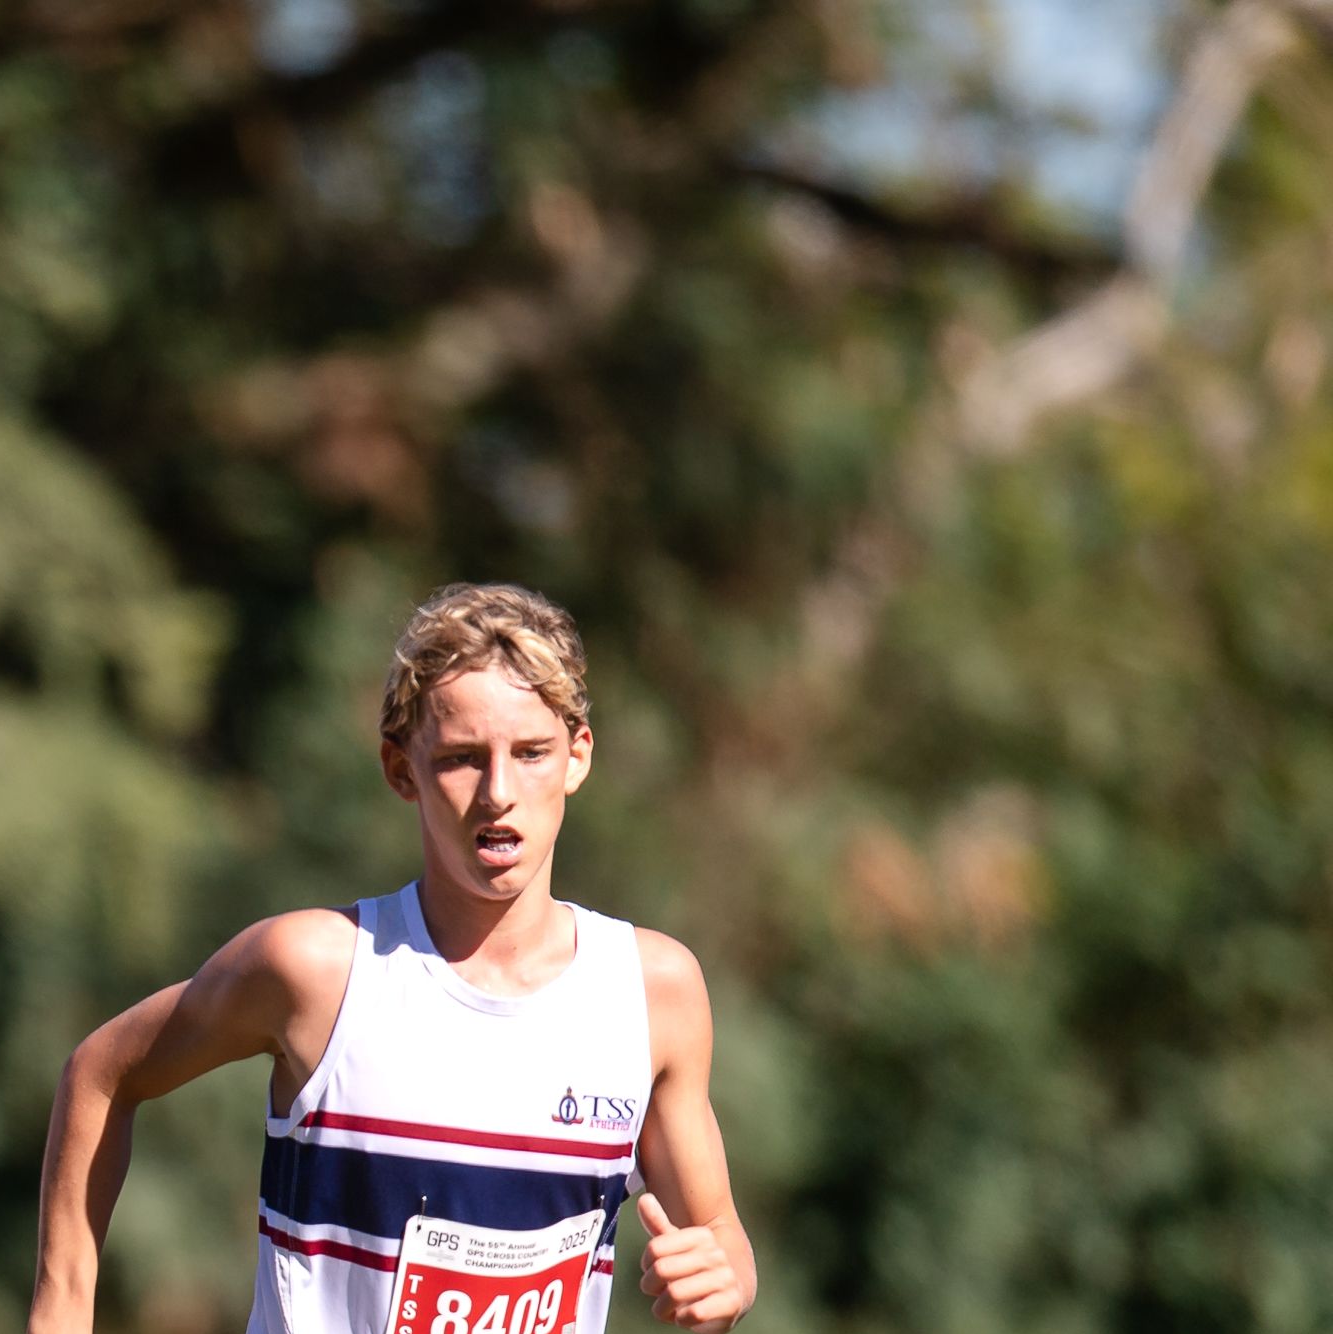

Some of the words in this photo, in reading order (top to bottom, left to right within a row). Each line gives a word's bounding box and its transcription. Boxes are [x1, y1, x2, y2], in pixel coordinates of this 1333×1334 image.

[582, 1095, 637, 1121] TSS
[426, 1230, 461, 1252] GPS
[469, 1238, 487, 1248] The
[558, 1229, 588, 1254] 2025
[466, 1248, 485, 1258] GPS
[486, 1251, 516, 1260] CROSS
